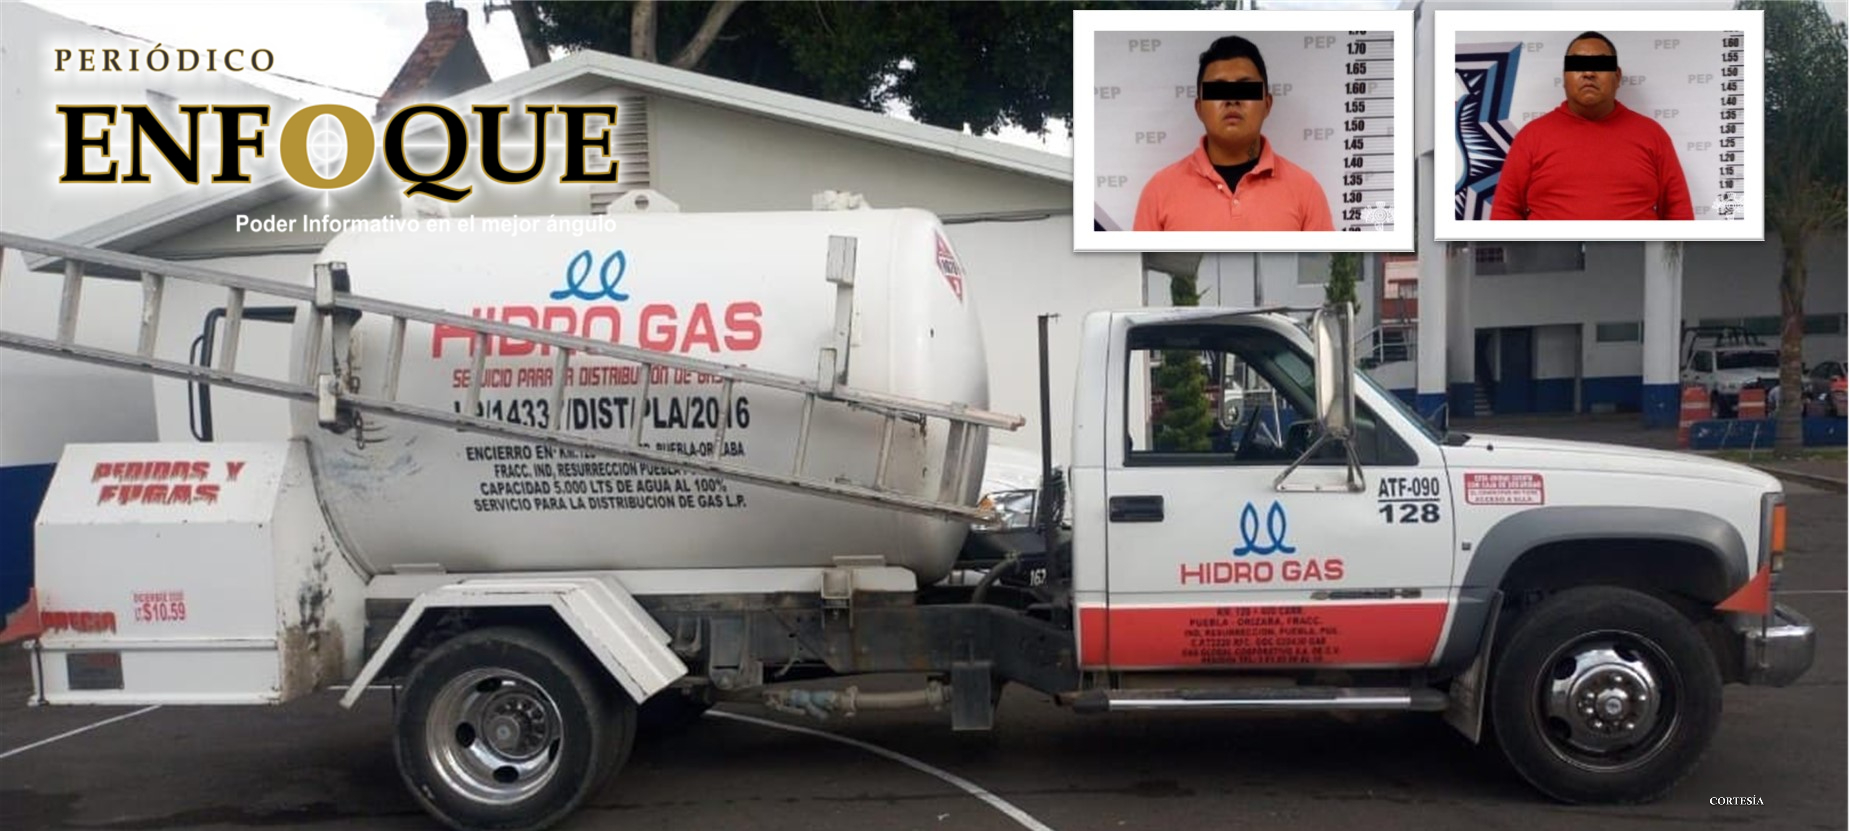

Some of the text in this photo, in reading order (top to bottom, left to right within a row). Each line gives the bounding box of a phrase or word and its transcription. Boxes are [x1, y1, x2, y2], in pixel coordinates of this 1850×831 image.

[1128, 39, 1162, 52] PEP
[1303, 36, 1336, 49] PEP
[1347, 42, 1366, 55] 1.70
[1654, 39, 1680, 50] PEP
[1721, 52, 1739, 62] 1.55
[1345, 62, 1367, 75] 1.65
[1688, 74, 1714, 84] PEP
[1175, 85, 1198, 98] PE
[1268, 83, 1293, 97] EP
[1345, 82, 1366, 94] 1.60
[1720, 82, 1737, 92] 1.45
[1344, 101, 1366, 113] 1.55
[1654, 109, 1680, 119] PEP
[1720, 110, 1737, 120] 1.35
[1344, 120, 1365, 132] 1.50
[1135, 131, 1167, 144] PEP
[1303, 128, 1335, 141] PEP
[1344, 138, 1364, 150] 1.45
[1687, 141, 1712, 151] PEP
[1719, 138, 1736, 148] 1.25
[1343, 157, 1363, 168] 1.40
[1096, 175, 1128, 188] PEP
[1342, 174, 1363, 186] 1.35
[1342, 192, 1362, 204] 1.30
[1342, 209, 1361, 221] 1.25
[1695, 206, 1711, 215] EP
[638, 302, 763, 354] GAS
[466, 445, 532, 461] ENCIERRO
[226, 461, 246, 482] Y
[557, 462, 638, 477] RESURRECCION
[480, 478, 727, 495] CAPACIDAD 5.000 LTS DE AGUA AL 100%
[1378, 476, 1440, 498] ATF-090
[97, 484, 221, 506] FUGAS
[474, 494, 747, 512] SERVICIO PARA LA DISTRIBUCION DE GAS L.P.
[1378, 503, 1441, 523] 128
[1180, 559, 1344, 585] HIDRO GAS
